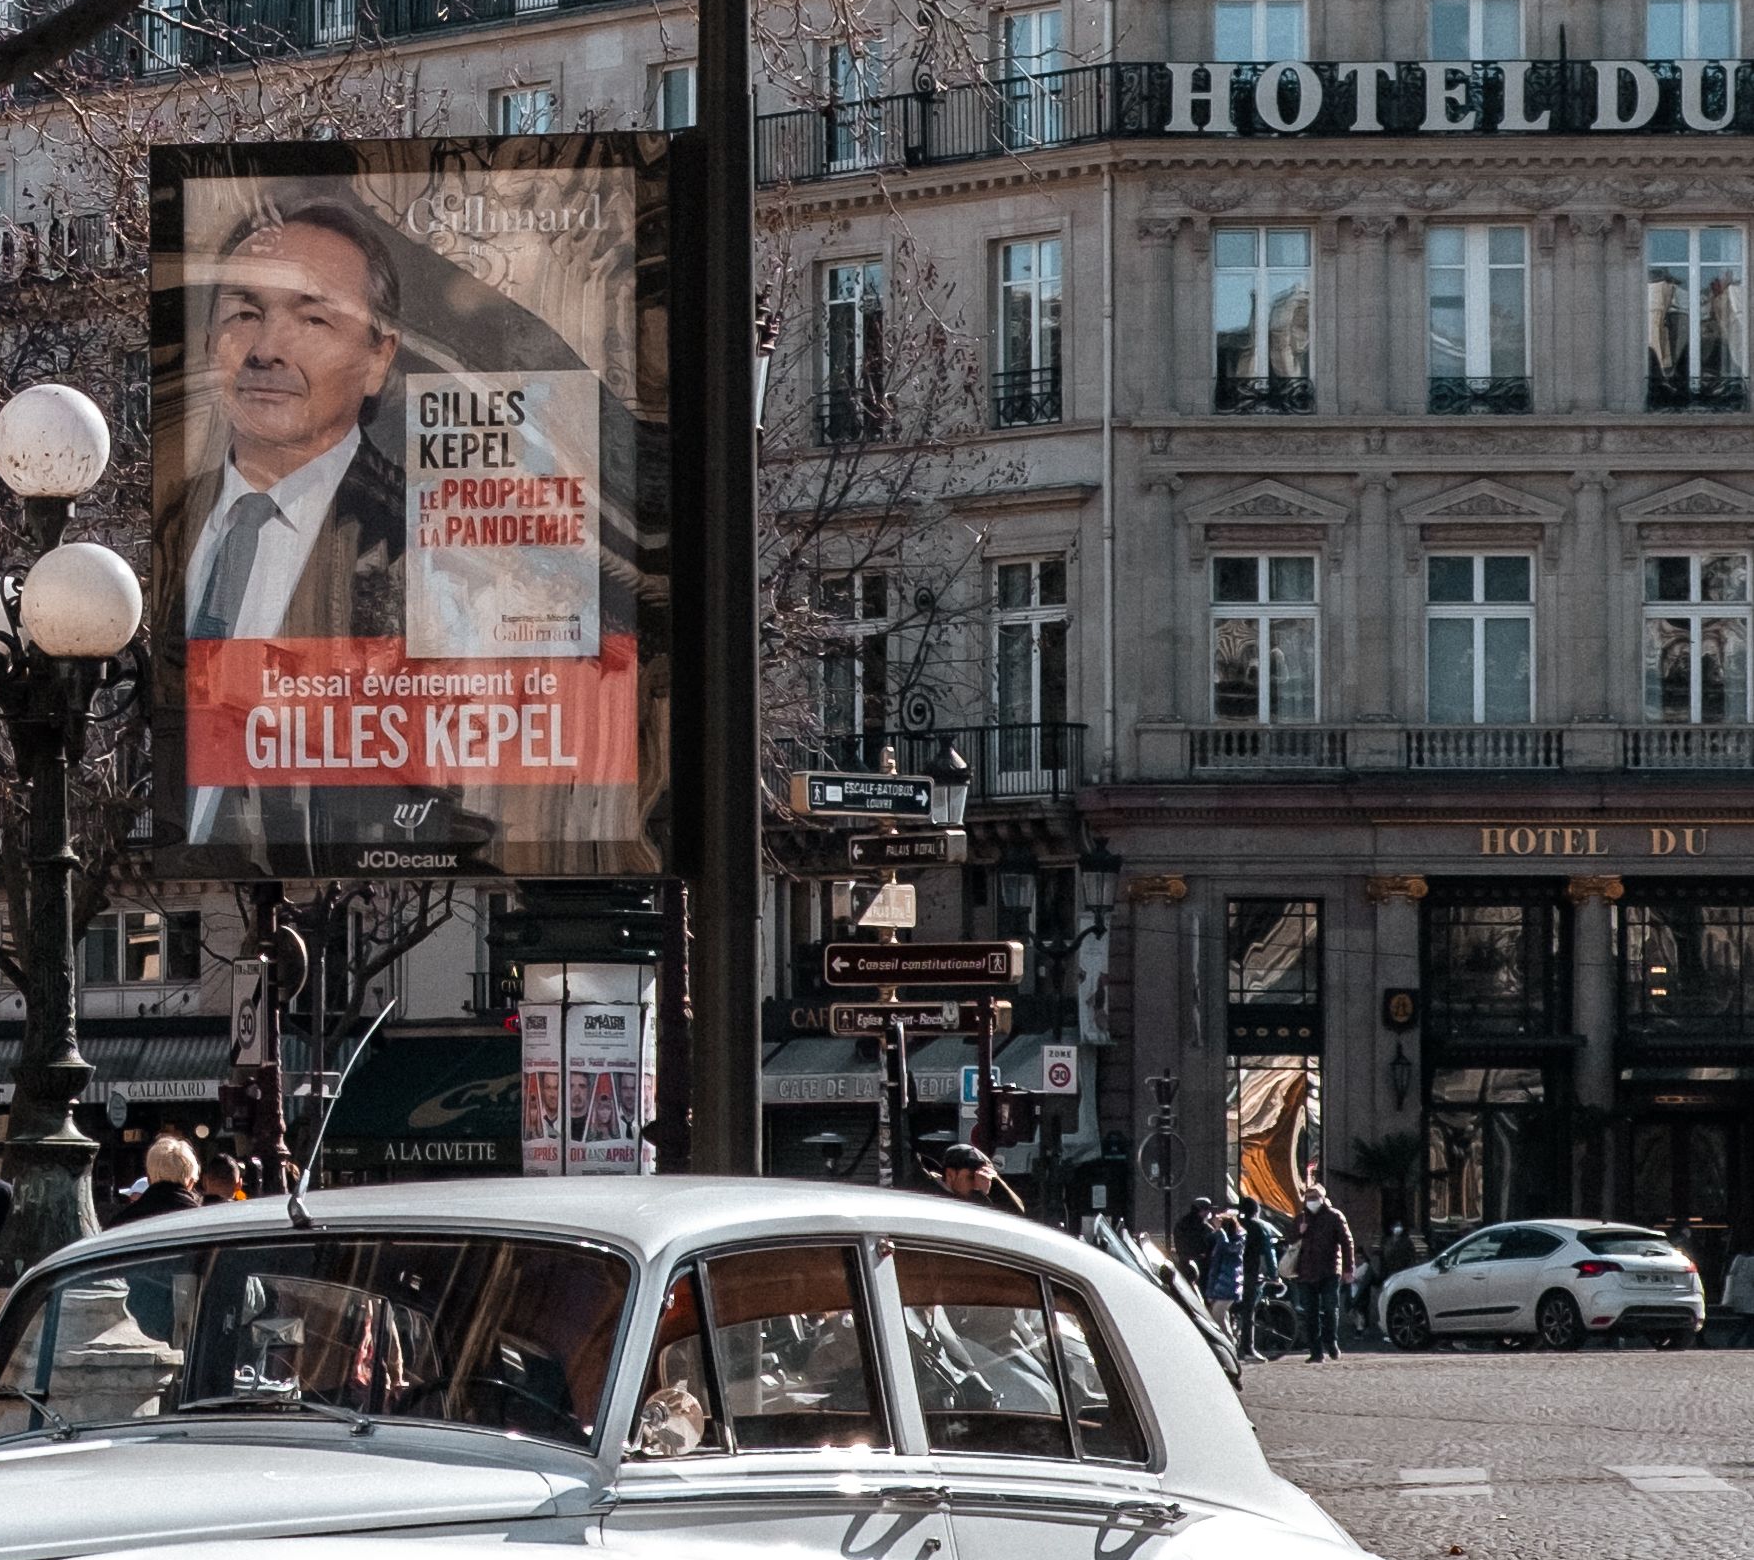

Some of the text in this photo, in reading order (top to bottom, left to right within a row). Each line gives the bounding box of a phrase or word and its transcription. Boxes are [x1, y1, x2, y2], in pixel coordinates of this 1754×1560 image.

[1163, 58, 1742, 133] HOTEL DU
[406, 193, 603, 235] Gallimard
[419, 390, 526, 429] GILLES
[419, 431, 516, 470] KEPEL
[419, 490, 439, 510] LE
[419, 527, 441, 548] LA
[493, 622, 582, 641] Gallimard
[362, 668, 514, 697] événement
[524, 667, 558, 696] de
[245, 703, 578, 770] GILLES KEPEL
[393, 797, 439, 828] nrf
[1479, 827, 1709, 855] HOTEL DU
[357, 851, 458, 870] JCDecaux
[857, 958, 986, 971] Conseil constitutionnel
[240, 1014, 253, 1035] 30
[1053, 1070, 1068, 1081] 30
[127, 1081, 206, 1098] GALLIMARD
[826, 1079, 847, 1096] DE
[855, 1079, 874, 1096] LA
[384, 1142, 497, 1161] A LA CIVETTE
